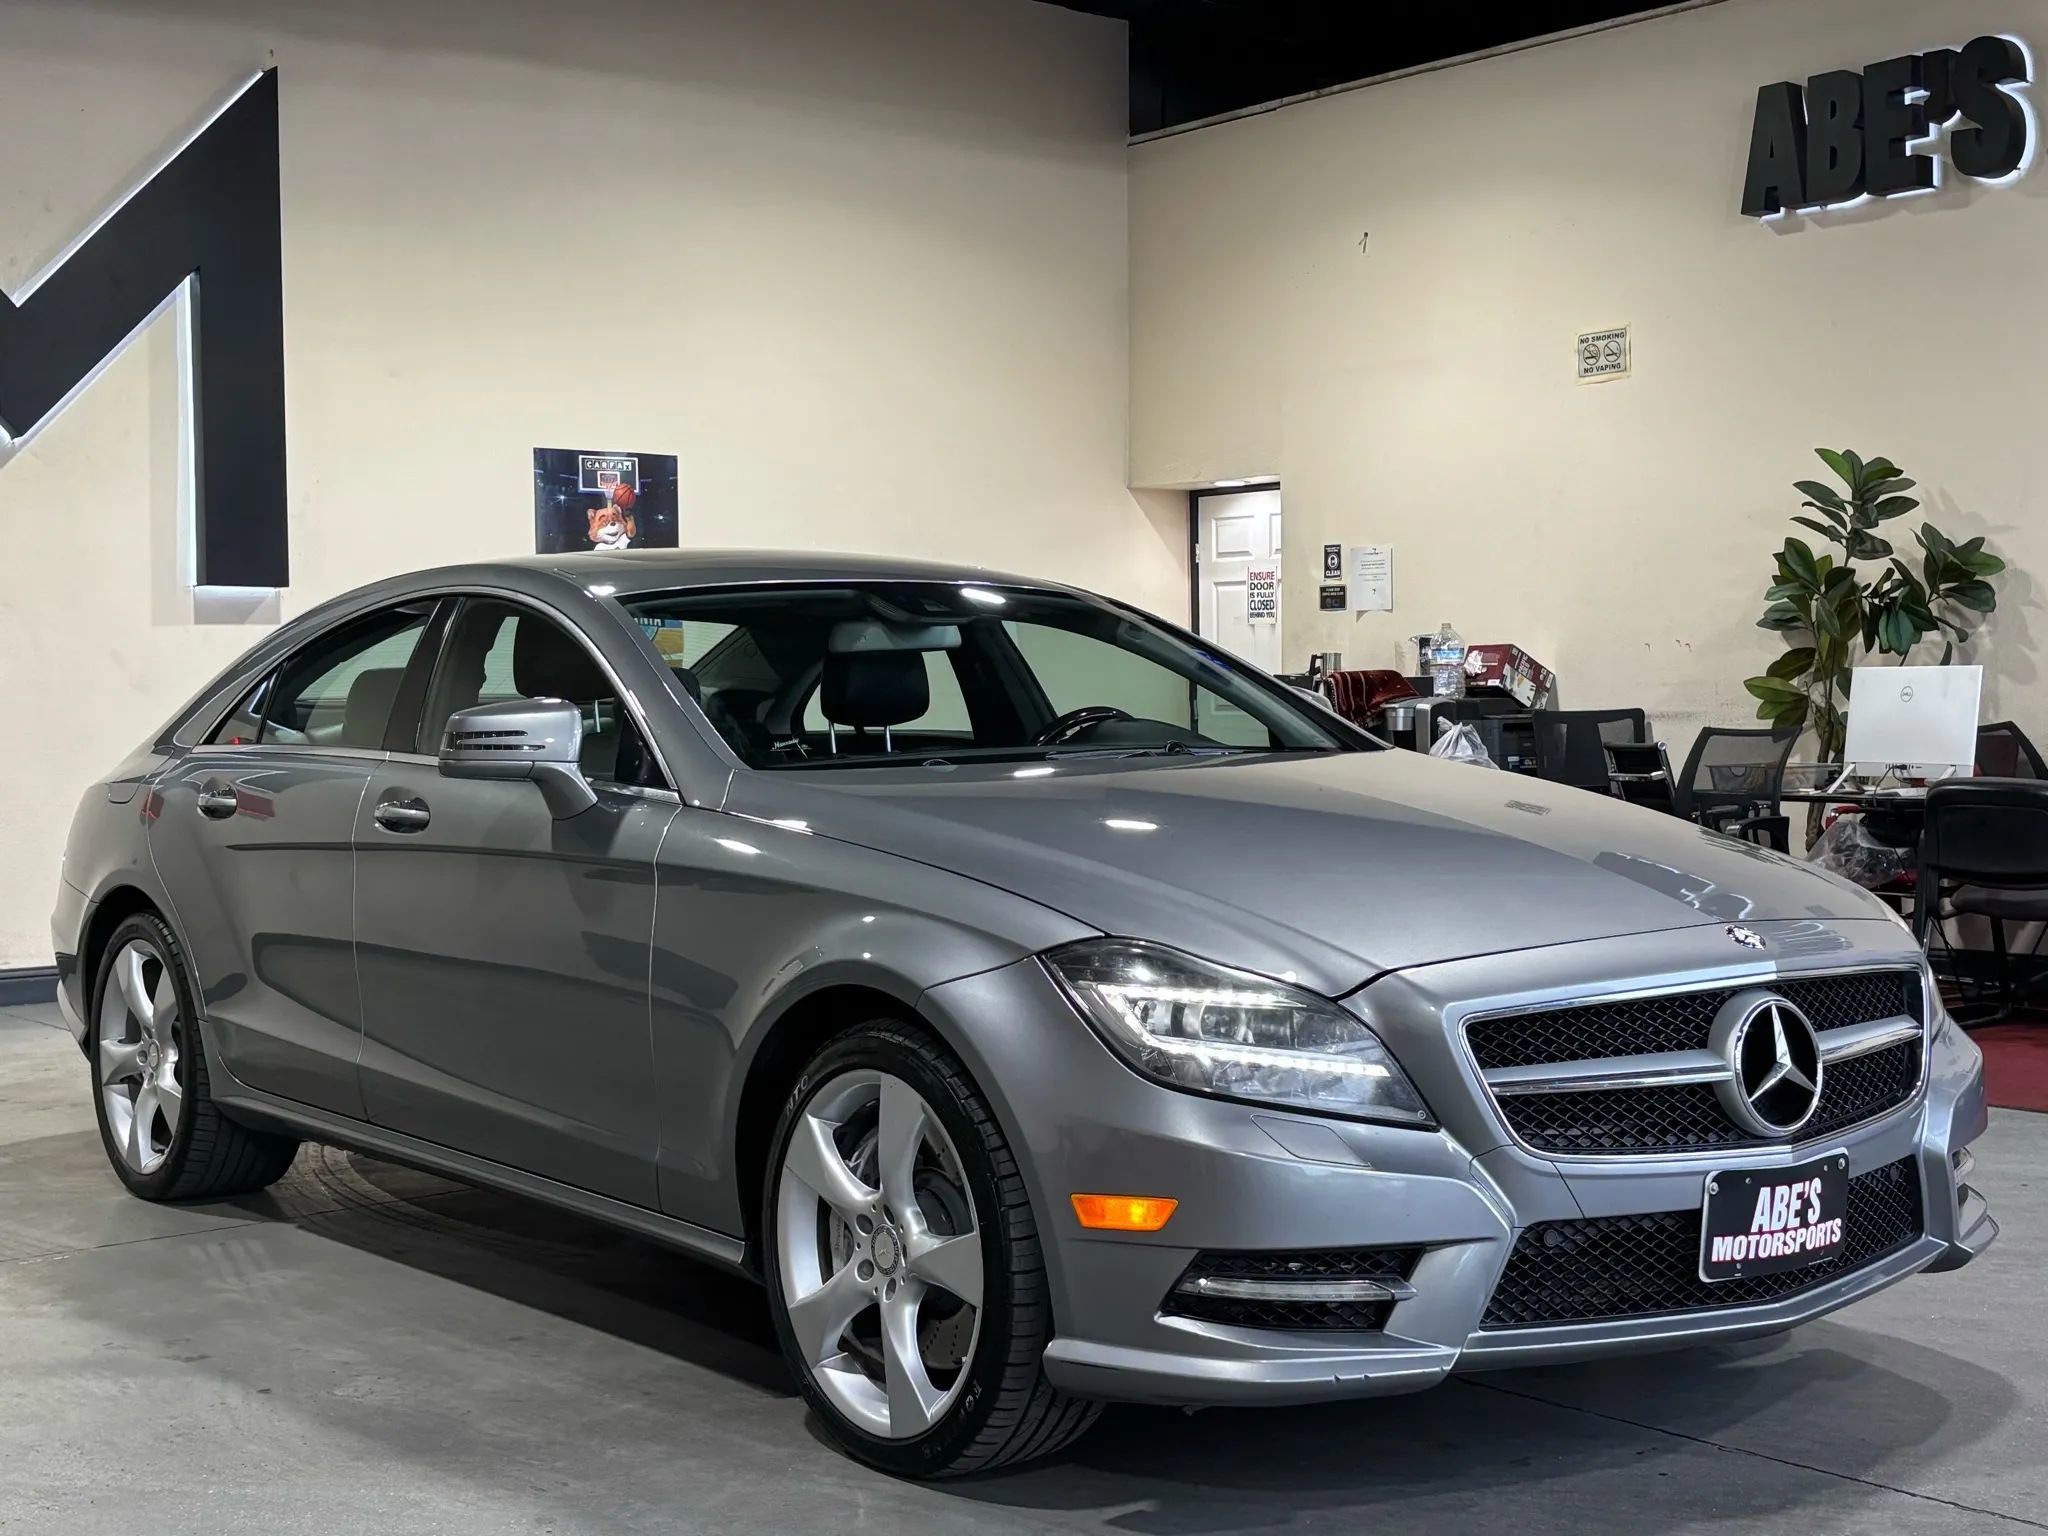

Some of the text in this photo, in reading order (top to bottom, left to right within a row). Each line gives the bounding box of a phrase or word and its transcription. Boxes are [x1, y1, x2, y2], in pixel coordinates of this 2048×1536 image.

[1741, 35, 2029, 218] ABE'S
[1591, 332, 1624, 342] SMOKING
[1596, 363, 1620, 372] VAPING
[585, 459, 632, 471] CARFAX
[1250, 571, 1275, 581] ENSURE
[1250, 582, 1274, 590] DOOR
[1250, 599, 1275, 611] CLOSED
[1750, 1177, 1822, 1233] ABE'S
[1711, 1218, 1842, 1262] MOTORSPORTS
